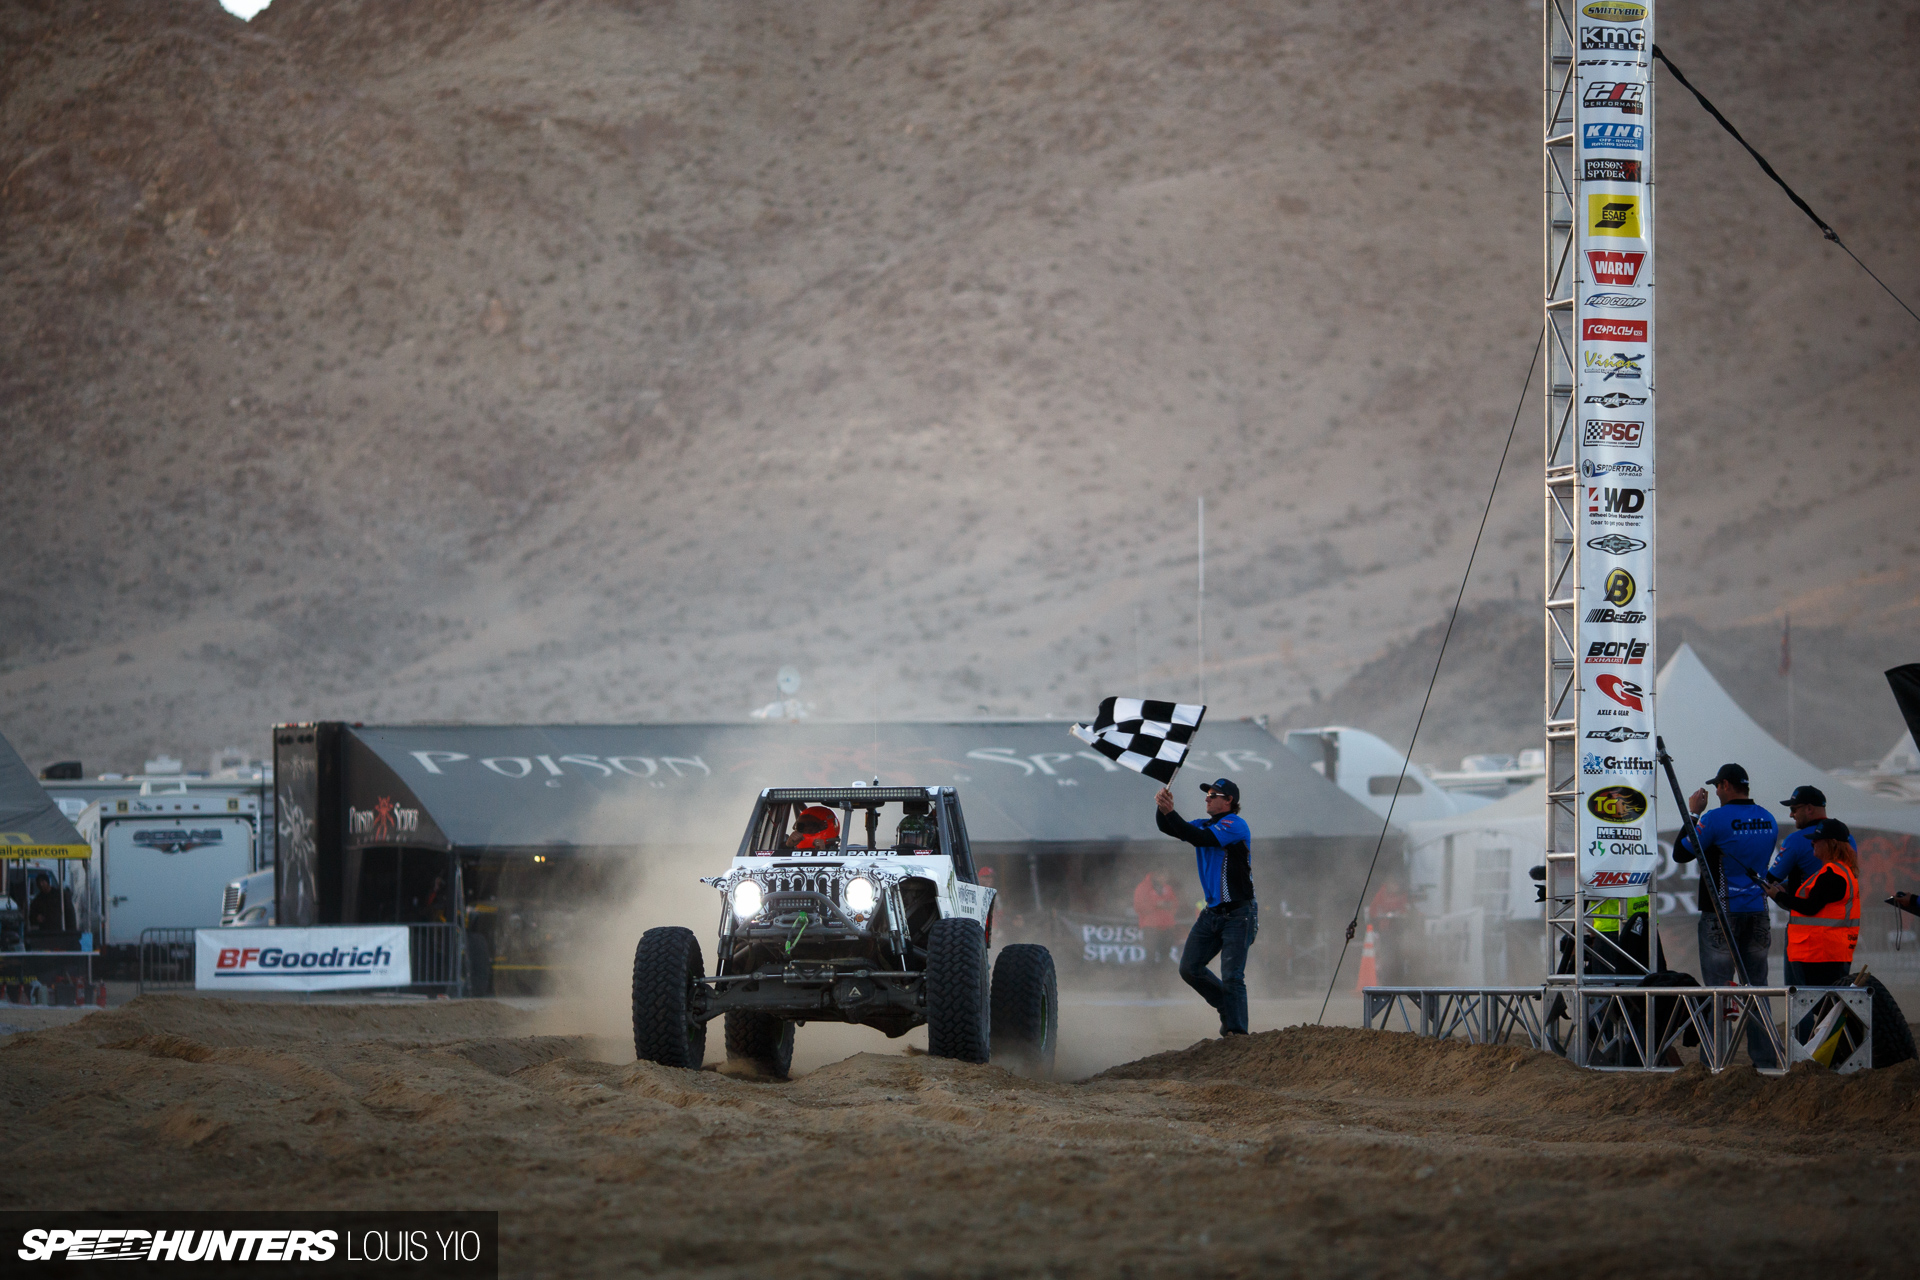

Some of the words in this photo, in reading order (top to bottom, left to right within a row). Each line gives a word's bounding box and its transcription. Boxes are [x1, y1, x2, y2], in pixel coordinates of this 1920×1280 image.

[1587, 6, 1646, 17] SMITTYBILT
[1585, 42, 1643, 50] WHEELS
[1586, 125, 1643, 138] KING
[1587, 160, 1624, 169] POISON
[1587, 171, 1627, 179] SPYDER
[1602, 211, 1626, 221] ESAB
[1595, 260, 1635, 276] WARN
[1584, 350, 1639, 369] Vision
[1601, 422, 1641, 442] PSC
[1588, 487, 1645, 513] 4WD
[1603, 756, 1654, 770] Griffin
[1593, 796, 1619, 815] TG
[1731, 818, 1773, 831] Griffin
[1598, 828, 1641, 836] METHOD
[1588, 871, 1651, 886] AMSOIL
[216, 946, 392, 969] BFGoodrich
